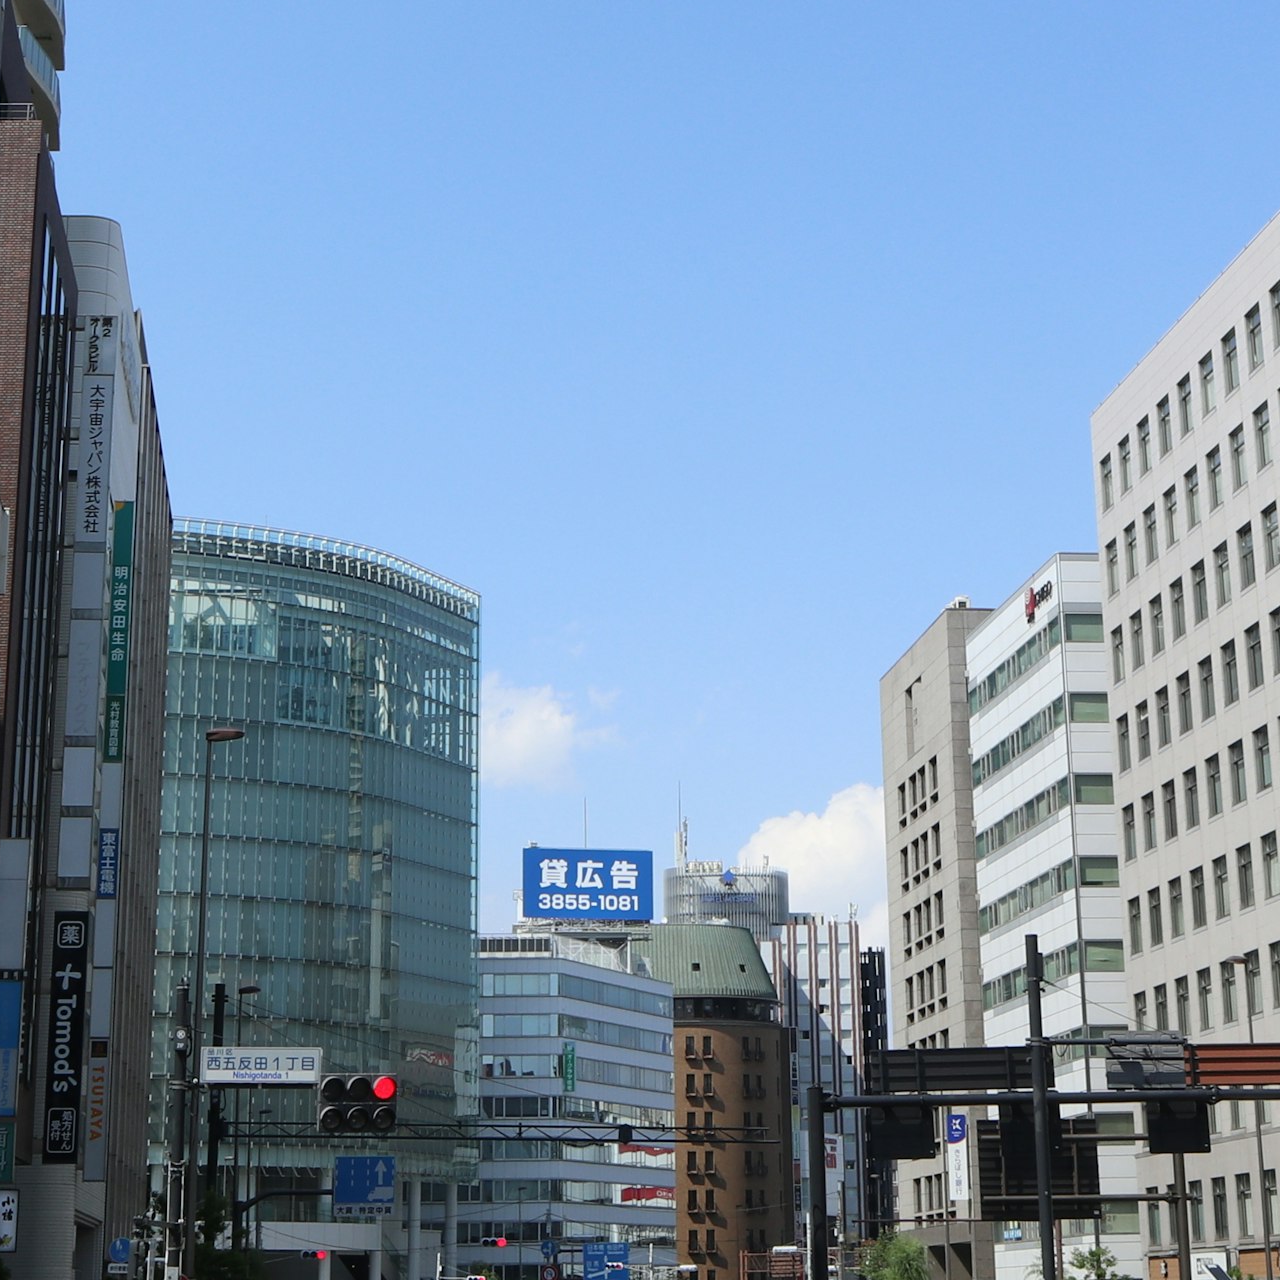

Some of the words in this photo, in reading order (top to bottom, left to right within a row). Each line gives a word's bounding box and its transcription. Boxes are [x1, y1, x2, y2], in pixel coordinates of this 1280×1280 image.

[83, 383, 105, 534] 大宇宙ジャパン株式会社
[110, 565, 129, 663] 明治安田生命
[539, 859, 639, 890] 貸広告
[538, 894, 639, 911] 3855-1081
[61, 925, 80, 944] 薬
[53, 997, 78, 1093] Tomod's
[206, 1056, 316, 1071] 西五反田1丁目
[232, 1071, 281, 1081] Nishigotanda
[88, 1065, 105, 1142] TSUTAYA
